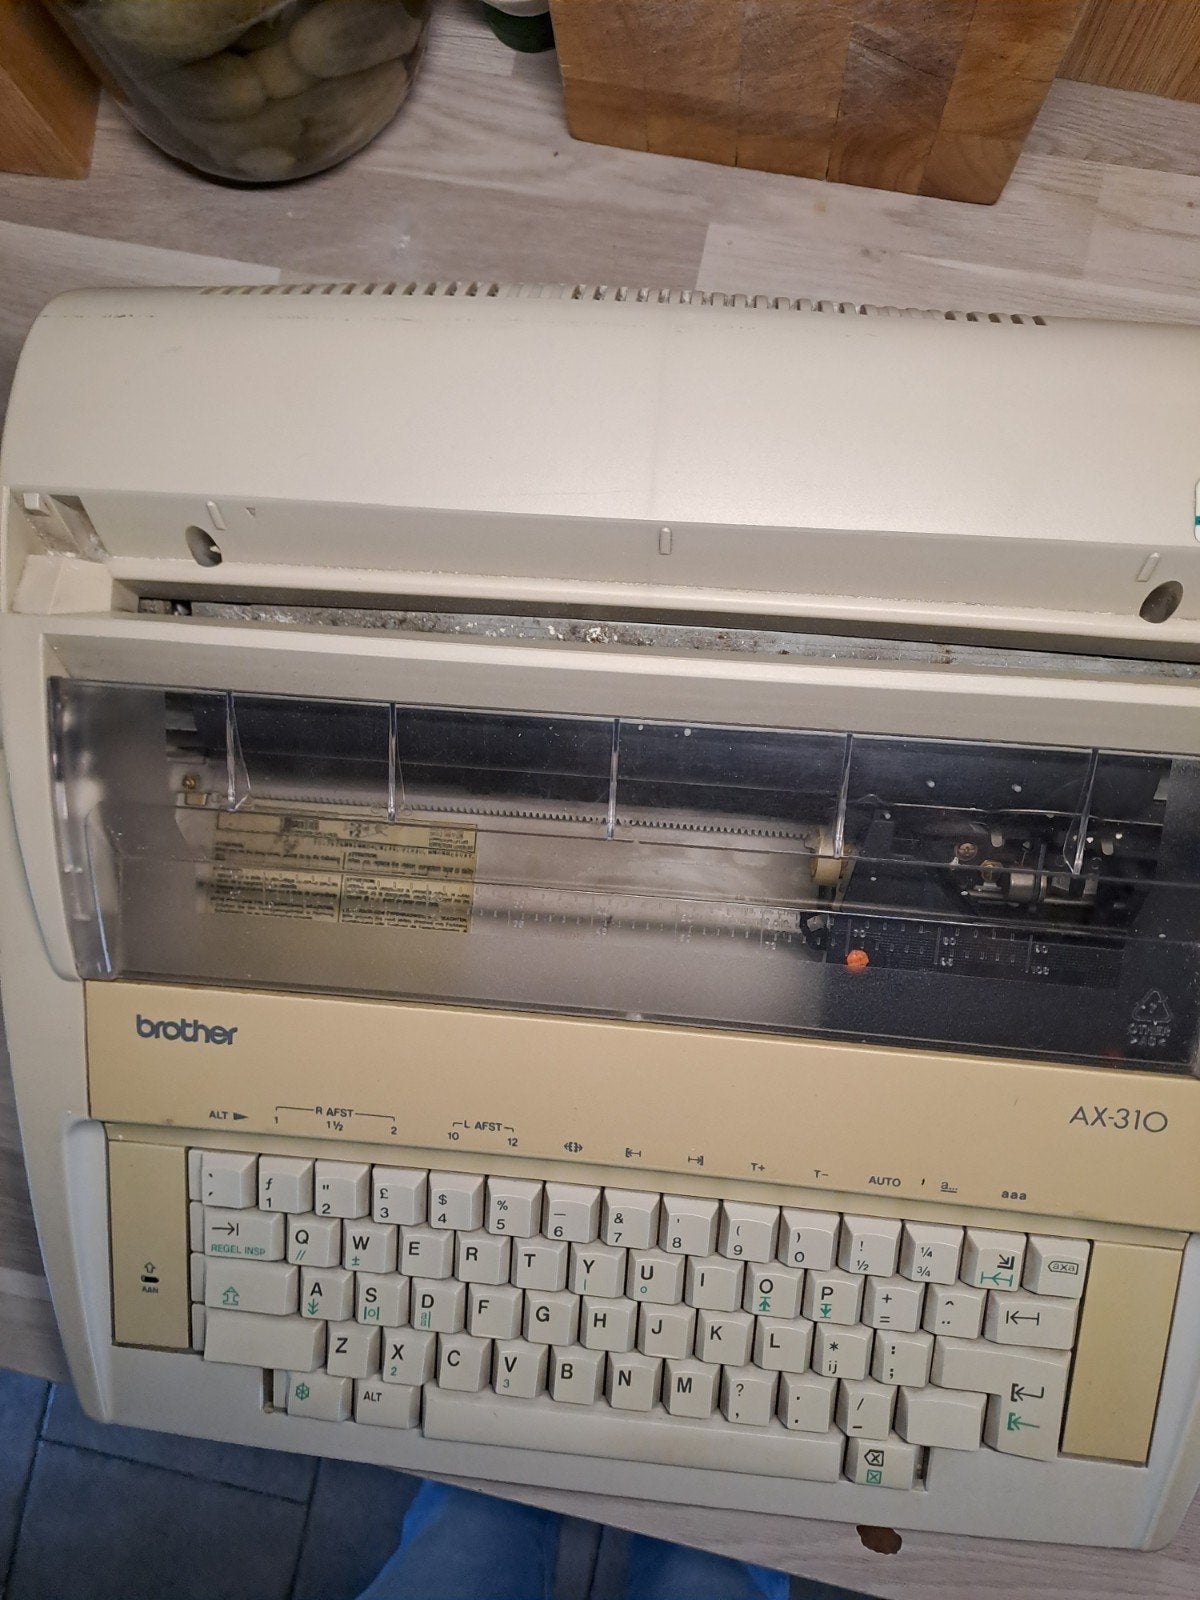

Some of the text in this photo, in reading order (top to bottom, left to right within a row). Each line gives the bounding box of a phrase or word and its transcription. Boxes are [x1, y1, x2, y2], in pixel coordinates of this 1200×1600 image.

[136, 1014, 238, 1045] brother
[209, 1111, 228, 1119] ALT
[313, 1106, 354, 1117] R AFST
[462, 1120, 502, 1131] L AFST
[1069, 1106, 1168, 1133] AX-310
[391, 1126, 397, 1135] 2
[448, 1132, 459, 1140] 10
[508, 1138, 518, 1146] 12
[869, 1176, 901, 1187] AUTO
[439, 1194, 447, 1205] $
[1002, 1191, 1026, 1200] aaa
[266, 1198, 271, 1208] 1
[321, 1203, 331, 1216] 2
[497, 1200, 508, 1210] %
[380, 1207, 389, 1218] 3
[438, 1214, 447, 1223] 4
[614, 1213, 623, 1224] &
[496, 1219, 505, 1230] 5
[295, 1230, 309, 1244] Q
[553, 1226, 563, 1238] 6
[614, 1232, 623, 1244] 7
[353, 1236, 370, 1250] W
[409, 1242, 420, 1255] E
[672, 1237, 681, 1248] 8
[210, 1243, 266, 1256] REGEL INSP
[466, 1247, 478, 1261] R
[734, 1245, 742, 1255] 9
[524, 1254, 536, 1267] T
[583, 1260, 595, 1273] Y
[641, 1265, 653, 1280] U
[311, 1282, 322, 1296] A
[759, 1279, 773, 1294] O
[366, 1288, 377, 1302] S
[821, 1287, 833, 1300] P
[422, 1294, 434, 1308] D
[478, 1300, 489, 1314] F
[536, 1306, 549, 1322] G
[594, 1313, 606, 1328] H
[652, 1320, 662, 1334] J
[711, 1326, 722, 1340] K
[335, 1338, 348, 1353] Z
[770, 1334, 780, 1348] L
[391, 1345, 404, 1360] X
[448, 1350, 460, 1366] C
[505, 1357, 517, 1372] V
[391, 1367, 397, 1376] 2
[561, 1364, 573, 1379] B
[619, 1370, 631, 1386] N
[503, 1379, 509, 1388] 3
[677, 1377, 692, 1393] M
[736, 1384, 744, 1396] ?
[364, 1391, 382, 1402] ALT
